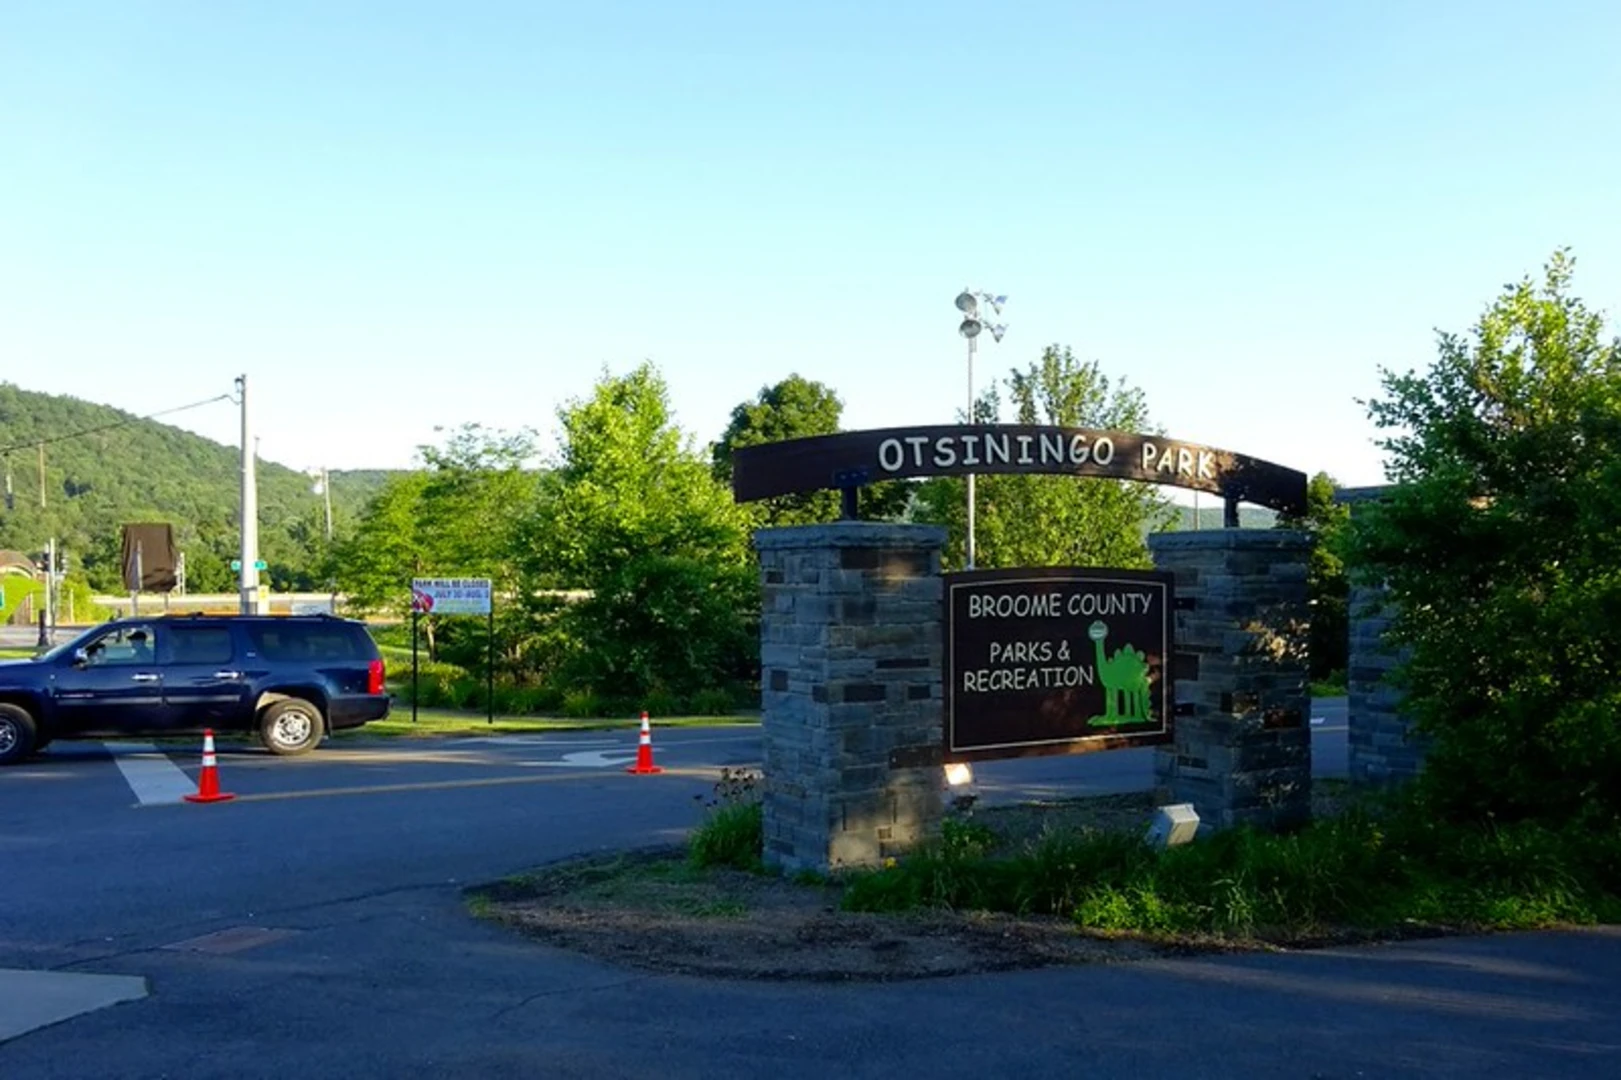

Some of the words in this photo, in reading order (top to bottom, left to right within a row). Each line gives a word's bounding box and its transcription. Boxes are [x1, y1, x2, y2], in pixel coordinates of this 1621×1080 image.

[878, 434, 1115, 472] OTSININGO
[1141, 442, 1217, 479] PARK
[968, 593, 1062, 618] BROOME
[1067, 593, 1153, 616] COUNTY
[990, 641, 1052, 664] PARKS
[1057, 640, 1070, 661] &
[964, 665, 1094, 692] RECREATION
